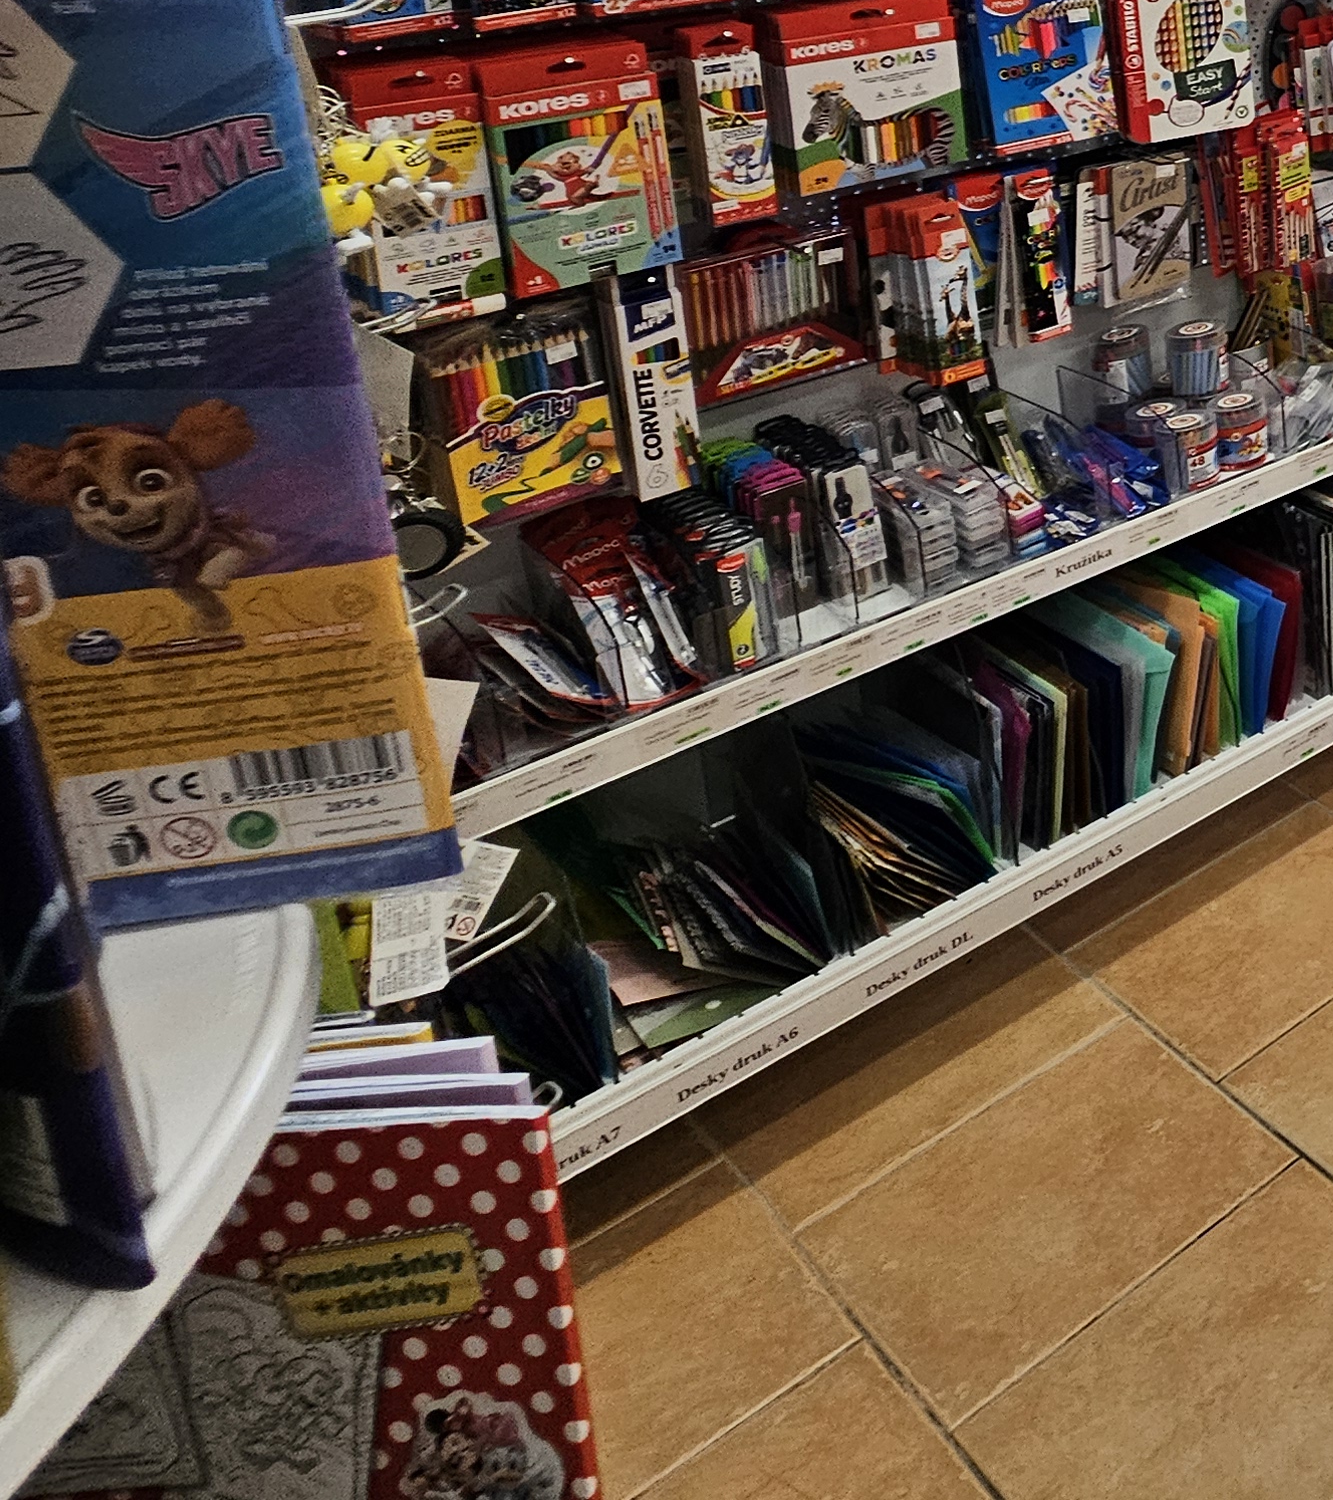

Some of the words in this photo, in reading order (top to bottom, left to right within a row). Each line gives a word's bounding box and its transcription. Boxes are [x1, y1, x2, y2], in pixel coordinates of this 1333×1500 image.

[1124, 0, 1136, 53] STABILO
[853, 48, 938, 75] KROMAS
[1186, 67, 1223, 85] EASY
[1189, 83, 1222, 98] Start
[150, 114, 284, 220] SKYE
[396, 249, 483, 274] KOLORES
[633, 314, 668, 334] MFP
[481, 394, 577, 449] Pastelky
[632, 369, 664, 462] CORVETTE
[1055, 548, 1113, 578] Kružítka
[1033, 871, 1071, 902] Desky
[1073, 855, 1104, 882] druk
[1106, 843, 1125, 863] A5
[865, 963, 911, 998] Desky
[913, 943, 950, 973] druk
[951, 931, 975, 950] DL
[676, 1068, 730, 1104] Desky
[732, 1044, 775, 1072] druk
[775, 1024, 800, 1050] A6
[595, 1125, 624, 1151] A7
